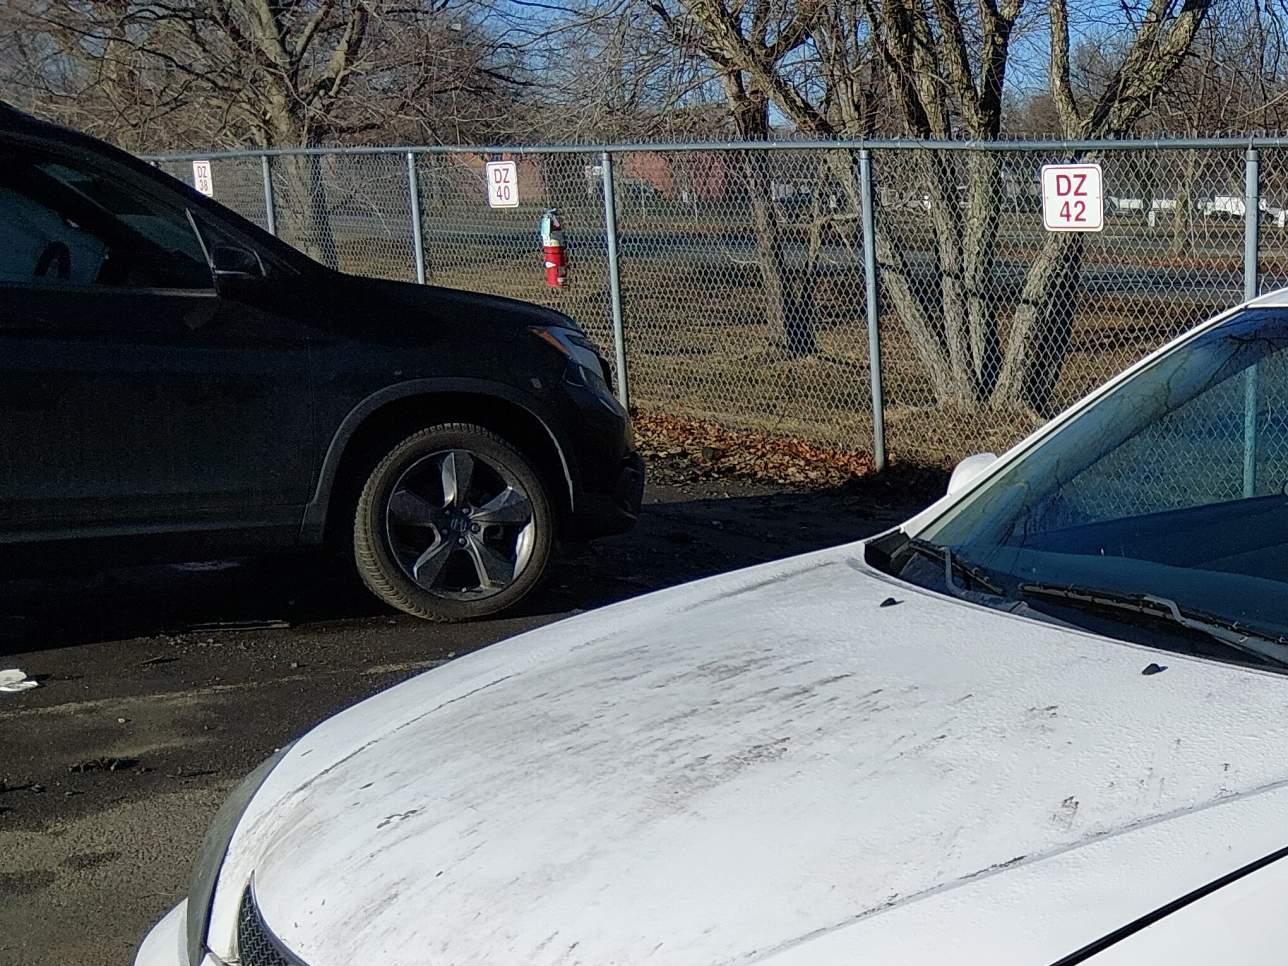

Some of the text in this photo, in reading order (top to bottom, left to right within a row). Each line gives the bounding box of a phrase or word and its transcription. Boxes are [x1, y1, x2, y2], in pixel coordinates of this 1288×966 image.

[197, 165, 207, 178] DZ
[493, 168, 510, 183] DZ
[496, 185, 511, 200] 40
[1056, 174, 1087, 196] DZ
[1059, 200, 1087, 222] 42
